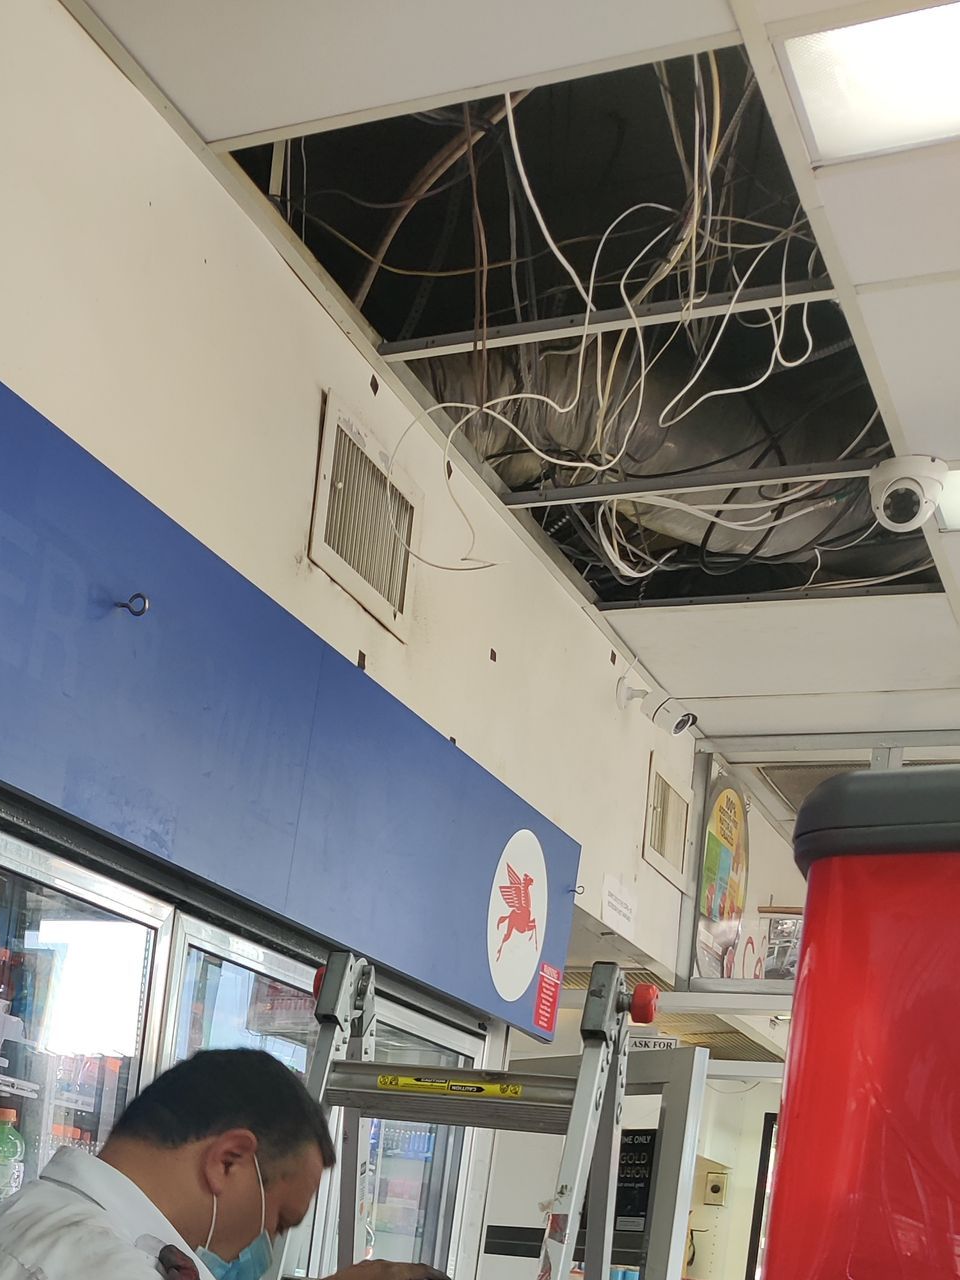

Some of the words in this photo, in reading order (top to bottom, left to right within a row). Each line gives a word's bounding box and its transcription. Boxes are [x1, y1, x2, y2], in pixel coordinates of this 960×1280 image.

[631, 1040, 651, 1049] ASK
[652, 1041, 673, 1050] FOR
[633, 1135, 652, 1145] ONLY
[619, 1152, 648, 1164] GOLD
[618, 1166, 650, 1178] USION
